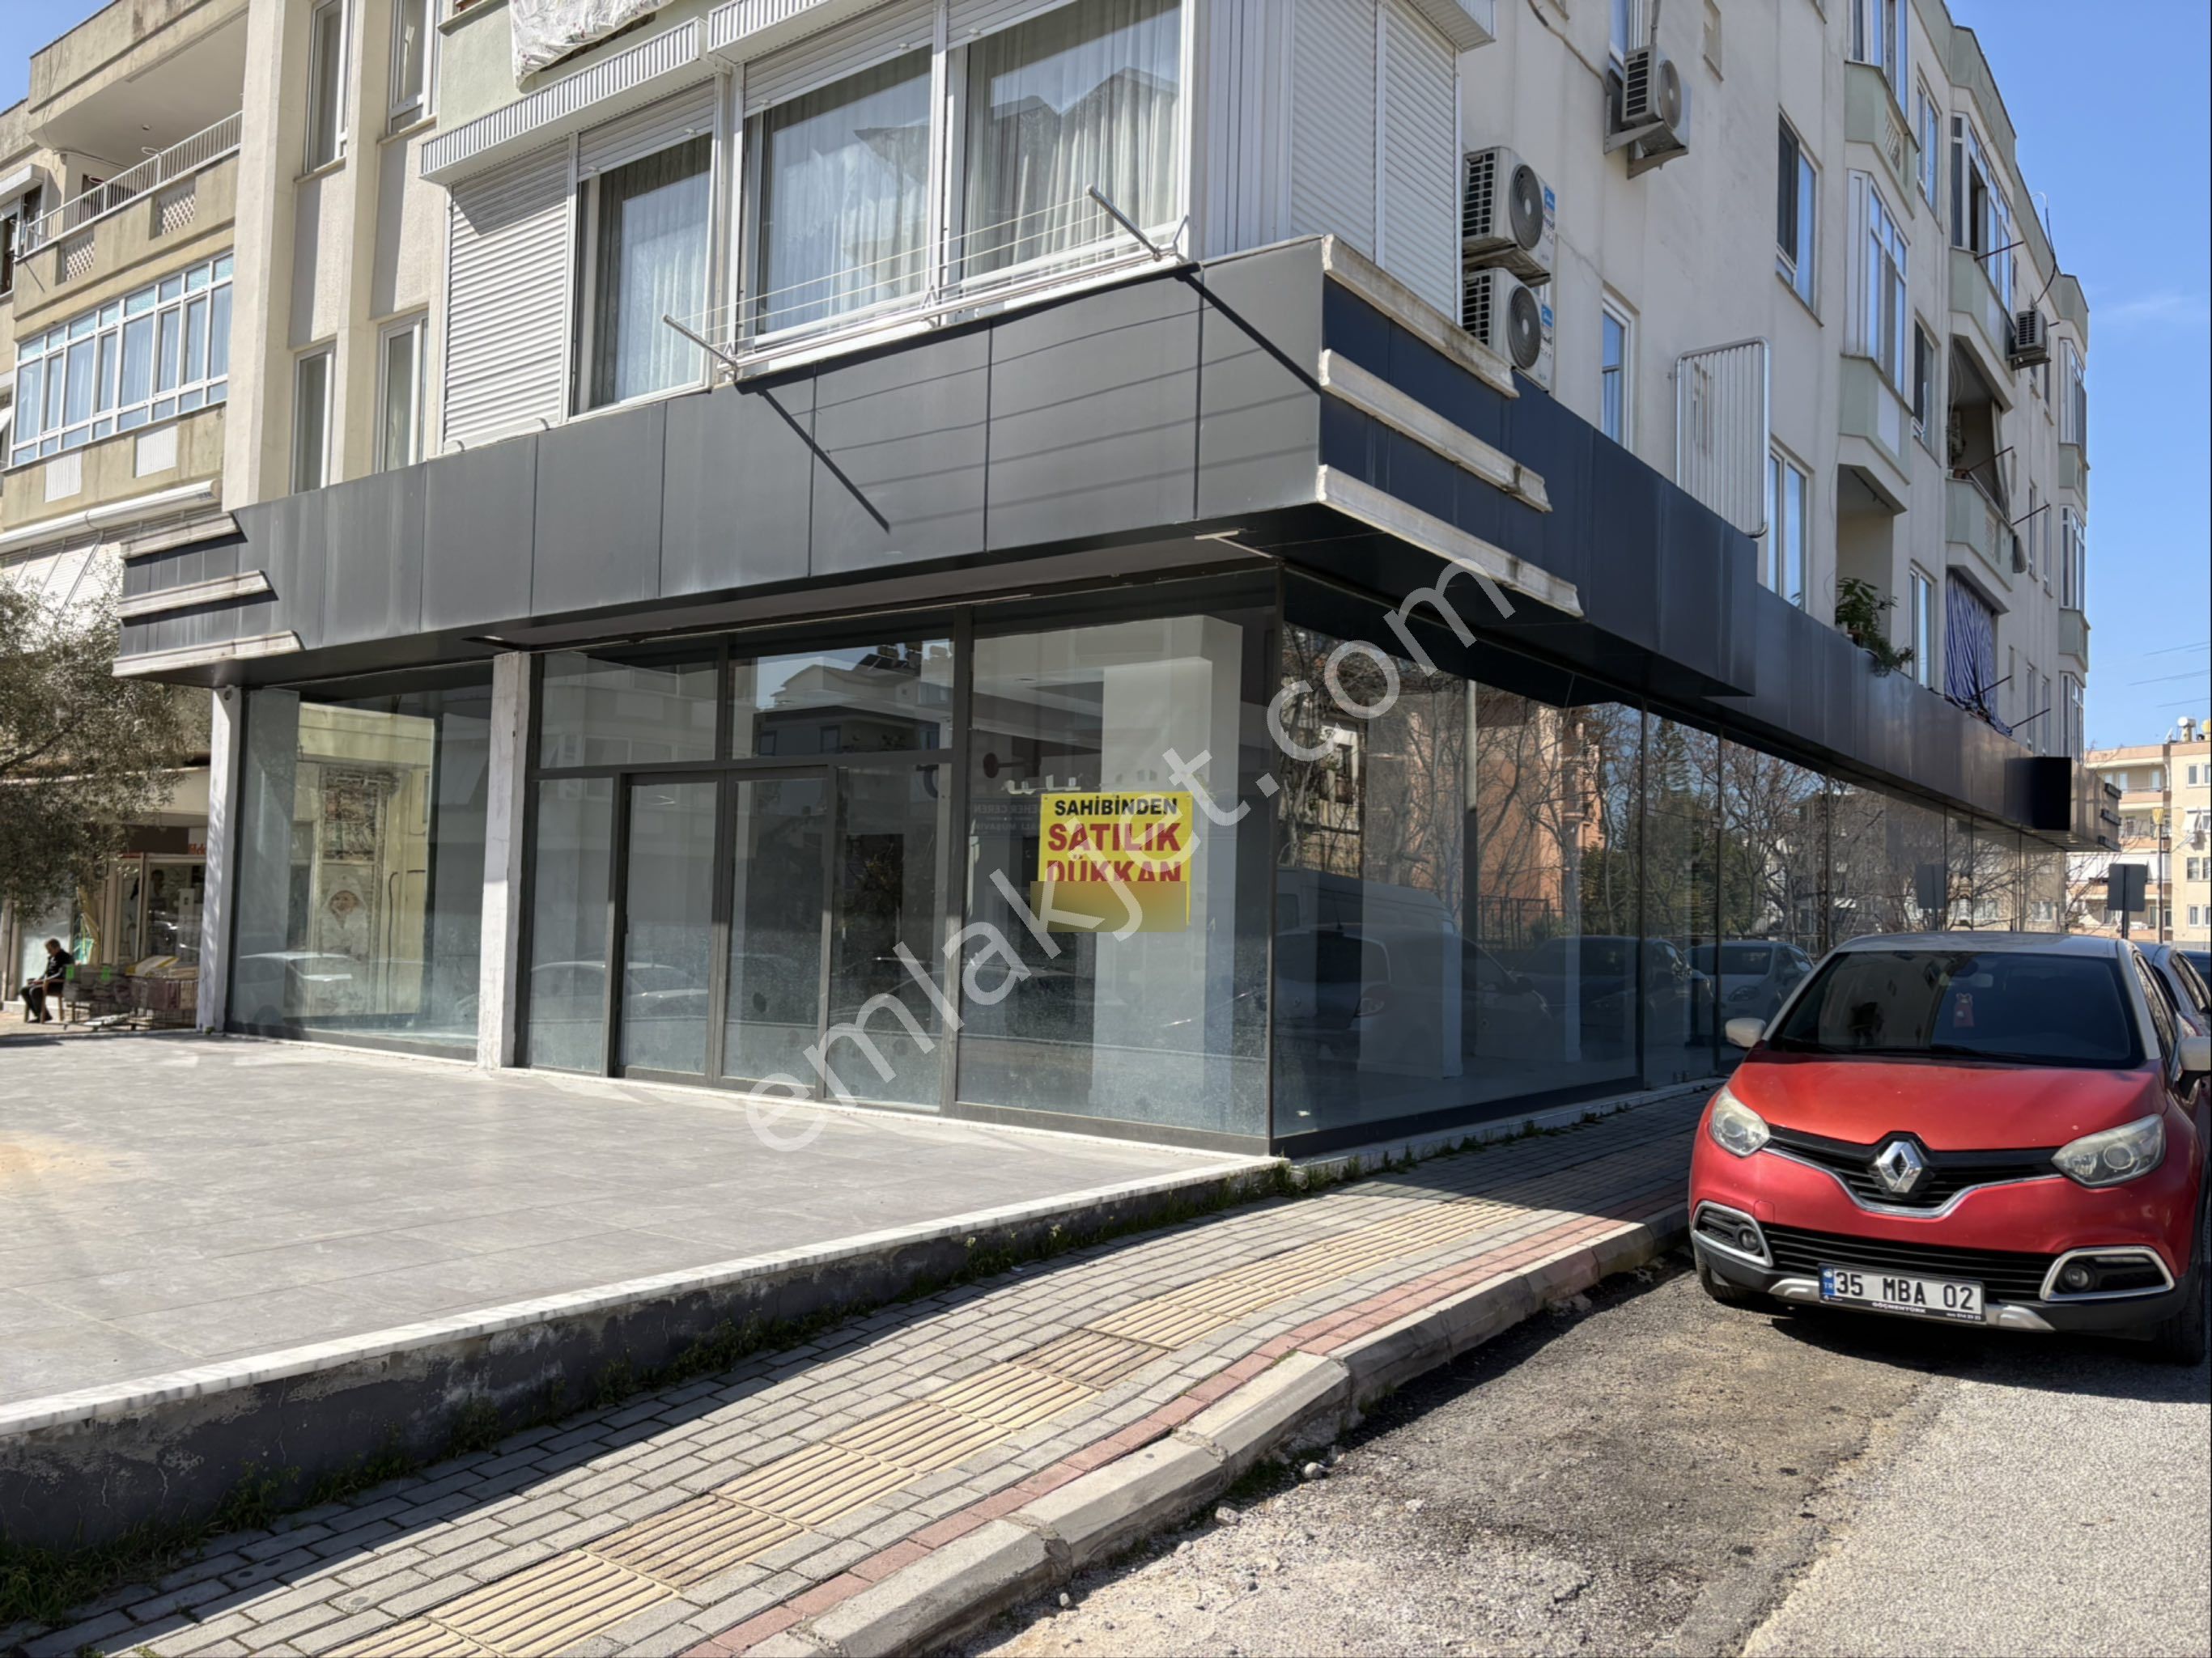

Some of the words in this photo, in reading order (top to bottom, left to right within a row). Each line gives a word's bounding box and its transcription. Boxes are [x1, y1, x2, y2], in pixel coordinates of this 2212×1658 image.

[1055, 795, 1178, 816] SAHİBİNDEN
[1047, 823, 1181, 851] SATILIK
[1047, 854, 1181, 881] DÜKKAN
[1824, 1281, 1834, 1290] TR
[1836, 1272, 1863, 1296] 35
[1883, 1278, 1926, 1304] MBA
[1943, 1284, 1973, 1310] 02
